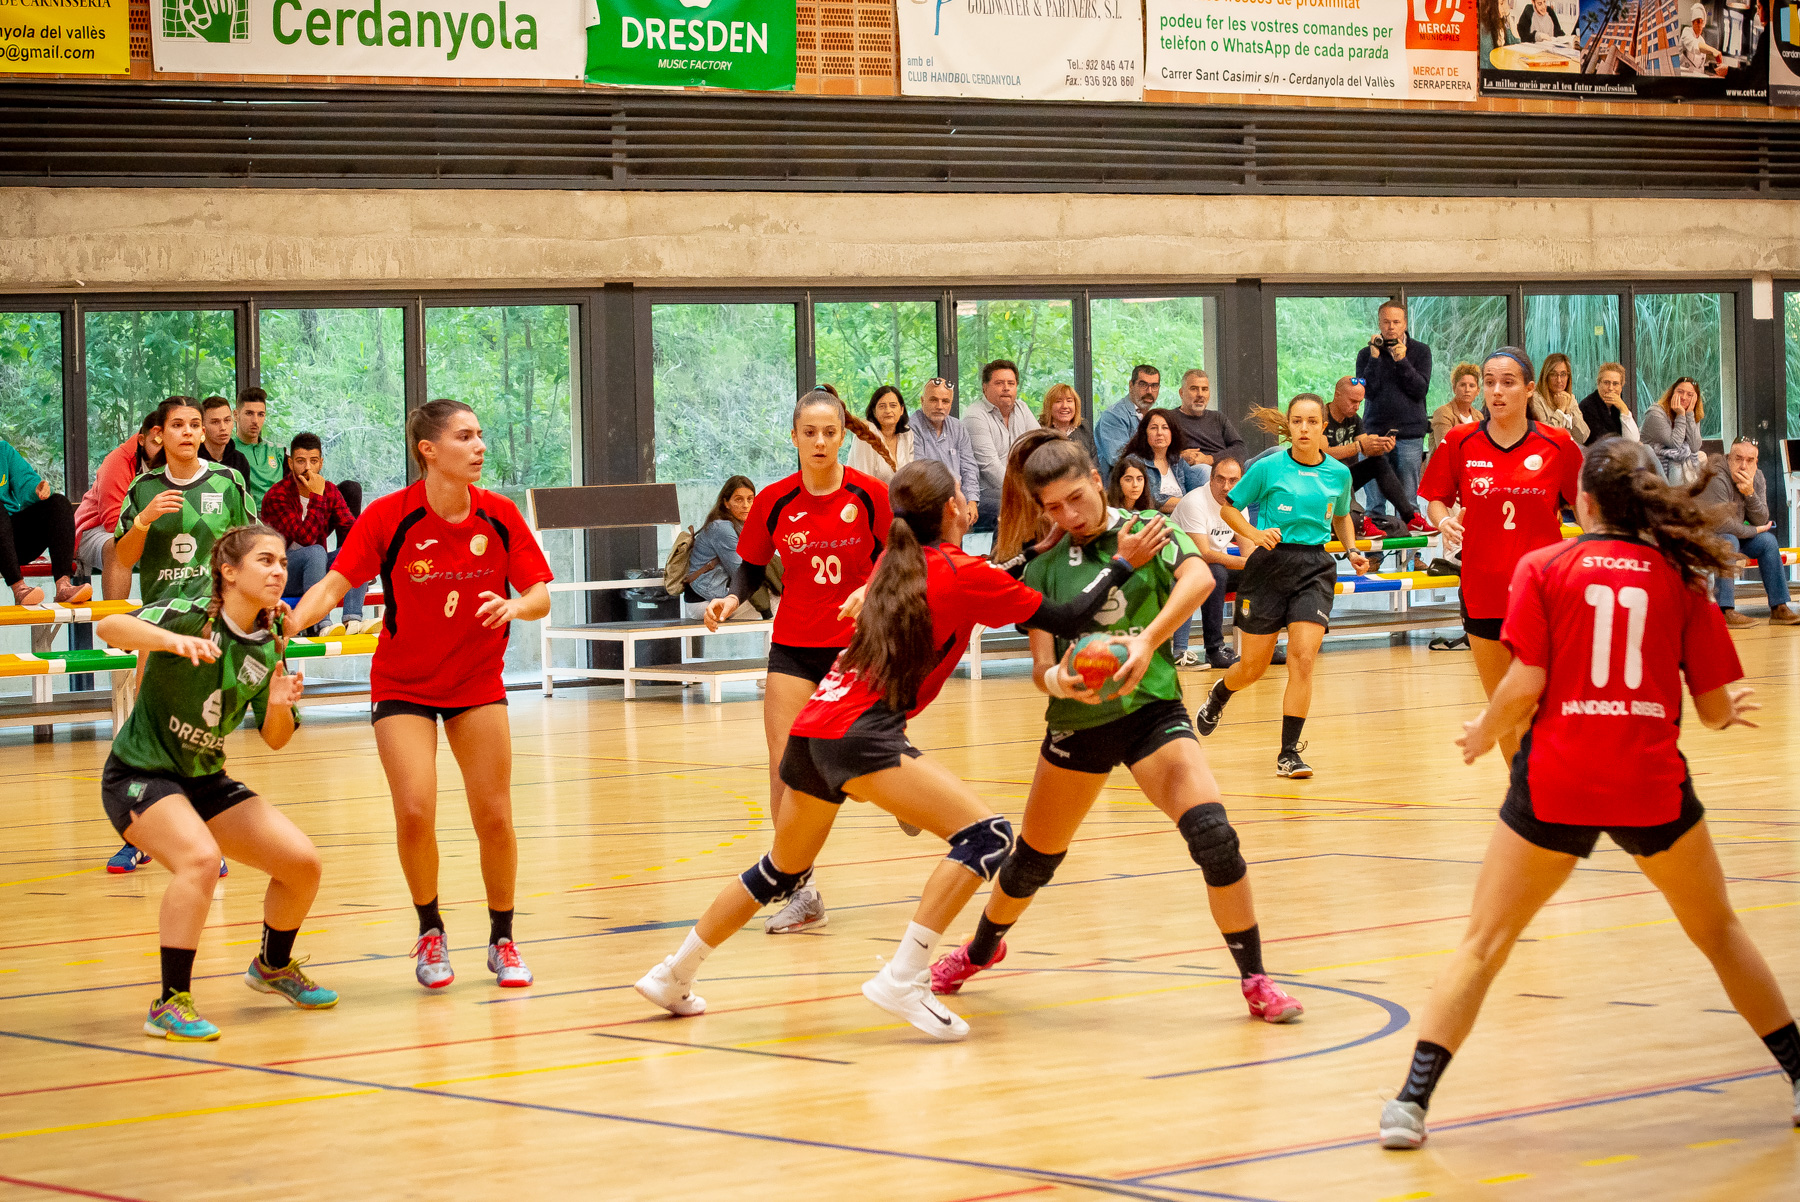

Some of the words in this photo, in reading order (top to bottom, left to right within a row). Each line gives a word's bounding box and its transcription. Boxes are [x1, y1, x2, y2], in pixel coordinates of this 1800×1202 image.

[968, 0, 1030, 16] GOLDWATER
[1033, 0, 1042, 17] &
[0, 25, 35, 41] yola
[40, 25, 62, 39] del
[66, 25, 106, 40] vallès
[272, 0, 538, 62] Cerdanyola
[622, 16, 768, 54] DRESDEN
[1160, 13, 1202, 30] podeu
[1206, 14, 1224, 30] fer
[1228, 15, 1247, 31] les
[1251, 19, 1299, 34] vostres
[1303, 22, 1369, 38] comandes
[1373, 26, 1393, 41] per
[1418, 23, 1461, 35] MERCATS
[1419, 33, 1461, 42] MUNICIPALS
[1160, 35, 1206, 51] telèfon
[1211, 40, 1219, 52] o
[1223, 37, 1290, 58] WhatsApp
[1295, 41, 1310, 56] de
[1314, 43, 1344, 58] cada
[1348, 45, 1389, 61] parada
[658, 59, 688, 69] MUSIC
[690, 60, 732, 71] FACTORY
[907, 57, 923, 67] amb
[926, 56, 934, 67] el
[1067, 59, 1083, 70] Tel.:
[1085, 60, 1099, 71] 932
[1100, 61, 1116, 71] 846
[1119, 61, 1135, 71] 474
[908, 71, 928, 83] CLUB
[930, 72, 970, 84] HANDBOL
[972, 74, 1021, 86] CERDANYOLA
[1161, 67, 1193, 80] Carrer
[1195, 68, 1219, 82] Sant
[1222, 70, 1261, 84] Casimir
[1264, 72, 1280, 84] s/n
[1289, 73, 1344, 89] Cerdanyola
[1347, 74, 1362, 87] del
[1365, 76, 1396, 88] Vallès
[1413, 66, 1443, 77] MERCAT
[1447, 67, 1459, 77] DE
[1065, 75, 1082, 87] Fax.:
[1085, 75, 1100, 87] 936
[1102, 76, 1118, 87] 928
[1120, 76, 1135, 87] 860
[1413, 80, 1472, 91] SERRAPERERA
[1484, 78, 1493, 87] La
[1495, 79, 1517, 88] millor
[1519, 81, 1538, 90] opció
[1540, 83, 1551, 91] per
[1552, 82, 1560, 90] al
[1561, 83, 1572, 91] teu
[1574, 82, 1592, 92] futur
[1594, 83, 1637, 93] professional.
[1726, 89, 1767, 97] www.cett.cat
[1502, 500, 1516, 530] 2
[1068, 546, 1083, 567] 9
[157, 564, 211, 581] DRESDEN
[811, 554, 842, 585] 20
[443, 590, 460, 618] 8
[1584, 583, 1649, 690] 11
[1561, 699, 1630, 716] HANDBOL
